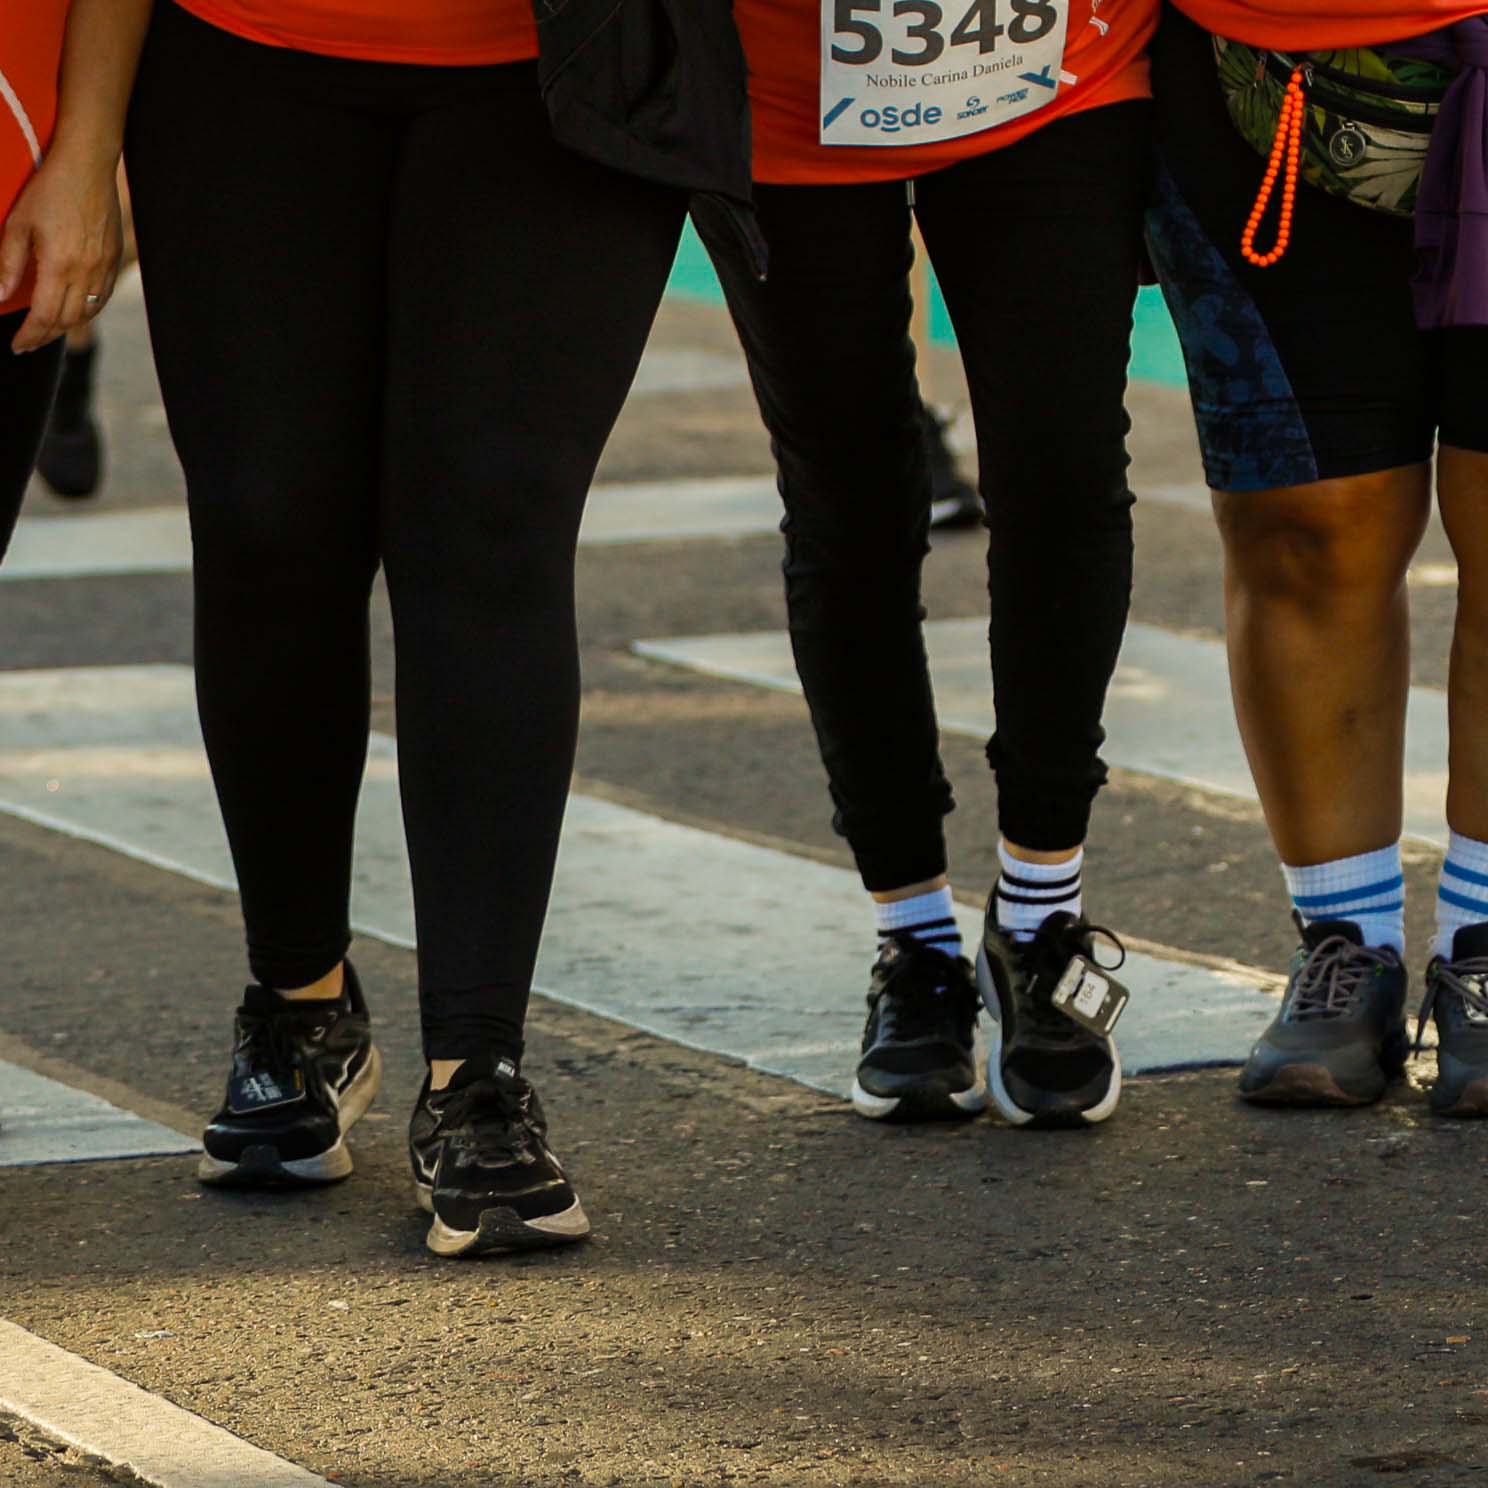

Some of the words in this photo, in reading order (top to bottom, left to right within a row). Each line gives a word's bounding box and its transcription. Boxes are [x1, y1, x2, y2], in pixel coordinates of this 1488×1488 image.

[866, 73, 917, 88] Nobile
[921, 67, 968, 86] Carina
[973, 53, 1023, 78] Daniela
[860, 101, 943, 132] osde
